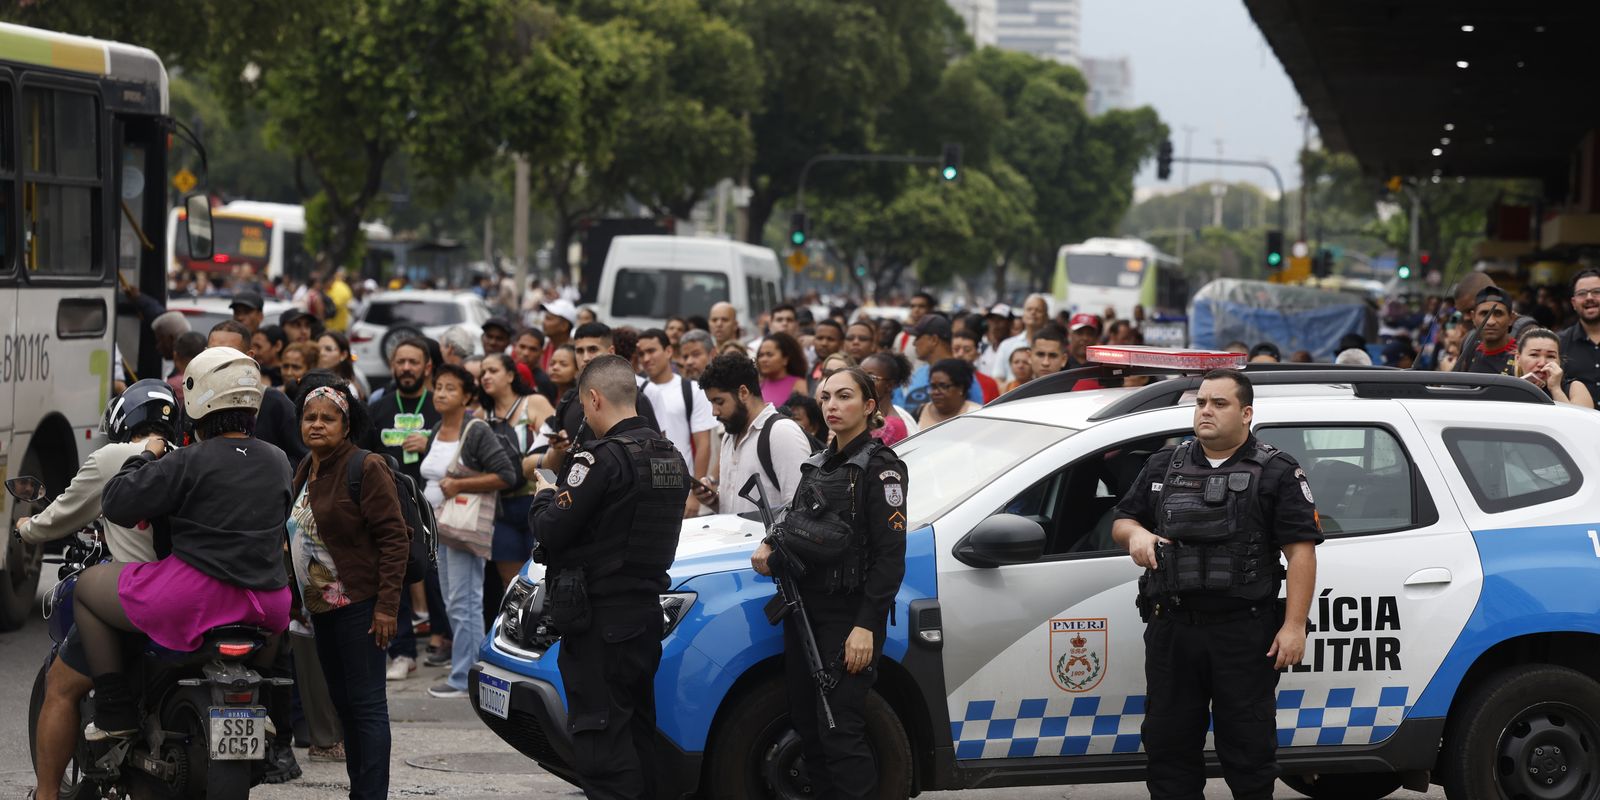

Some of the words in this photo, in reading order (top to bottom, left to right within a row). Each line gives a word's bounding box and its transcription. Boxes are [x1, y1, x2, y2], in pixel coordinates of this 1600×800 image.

[4, 333, 49, 382] B10116
[653, 474, 682, 487] MILITAR
[1307, 588, 1402, 632] ÍCIA
[1053, 620, 1105, 630] PMERJ
[223, 719, 254, 736] SSB
[218, 737, 258, 754] 6C59
